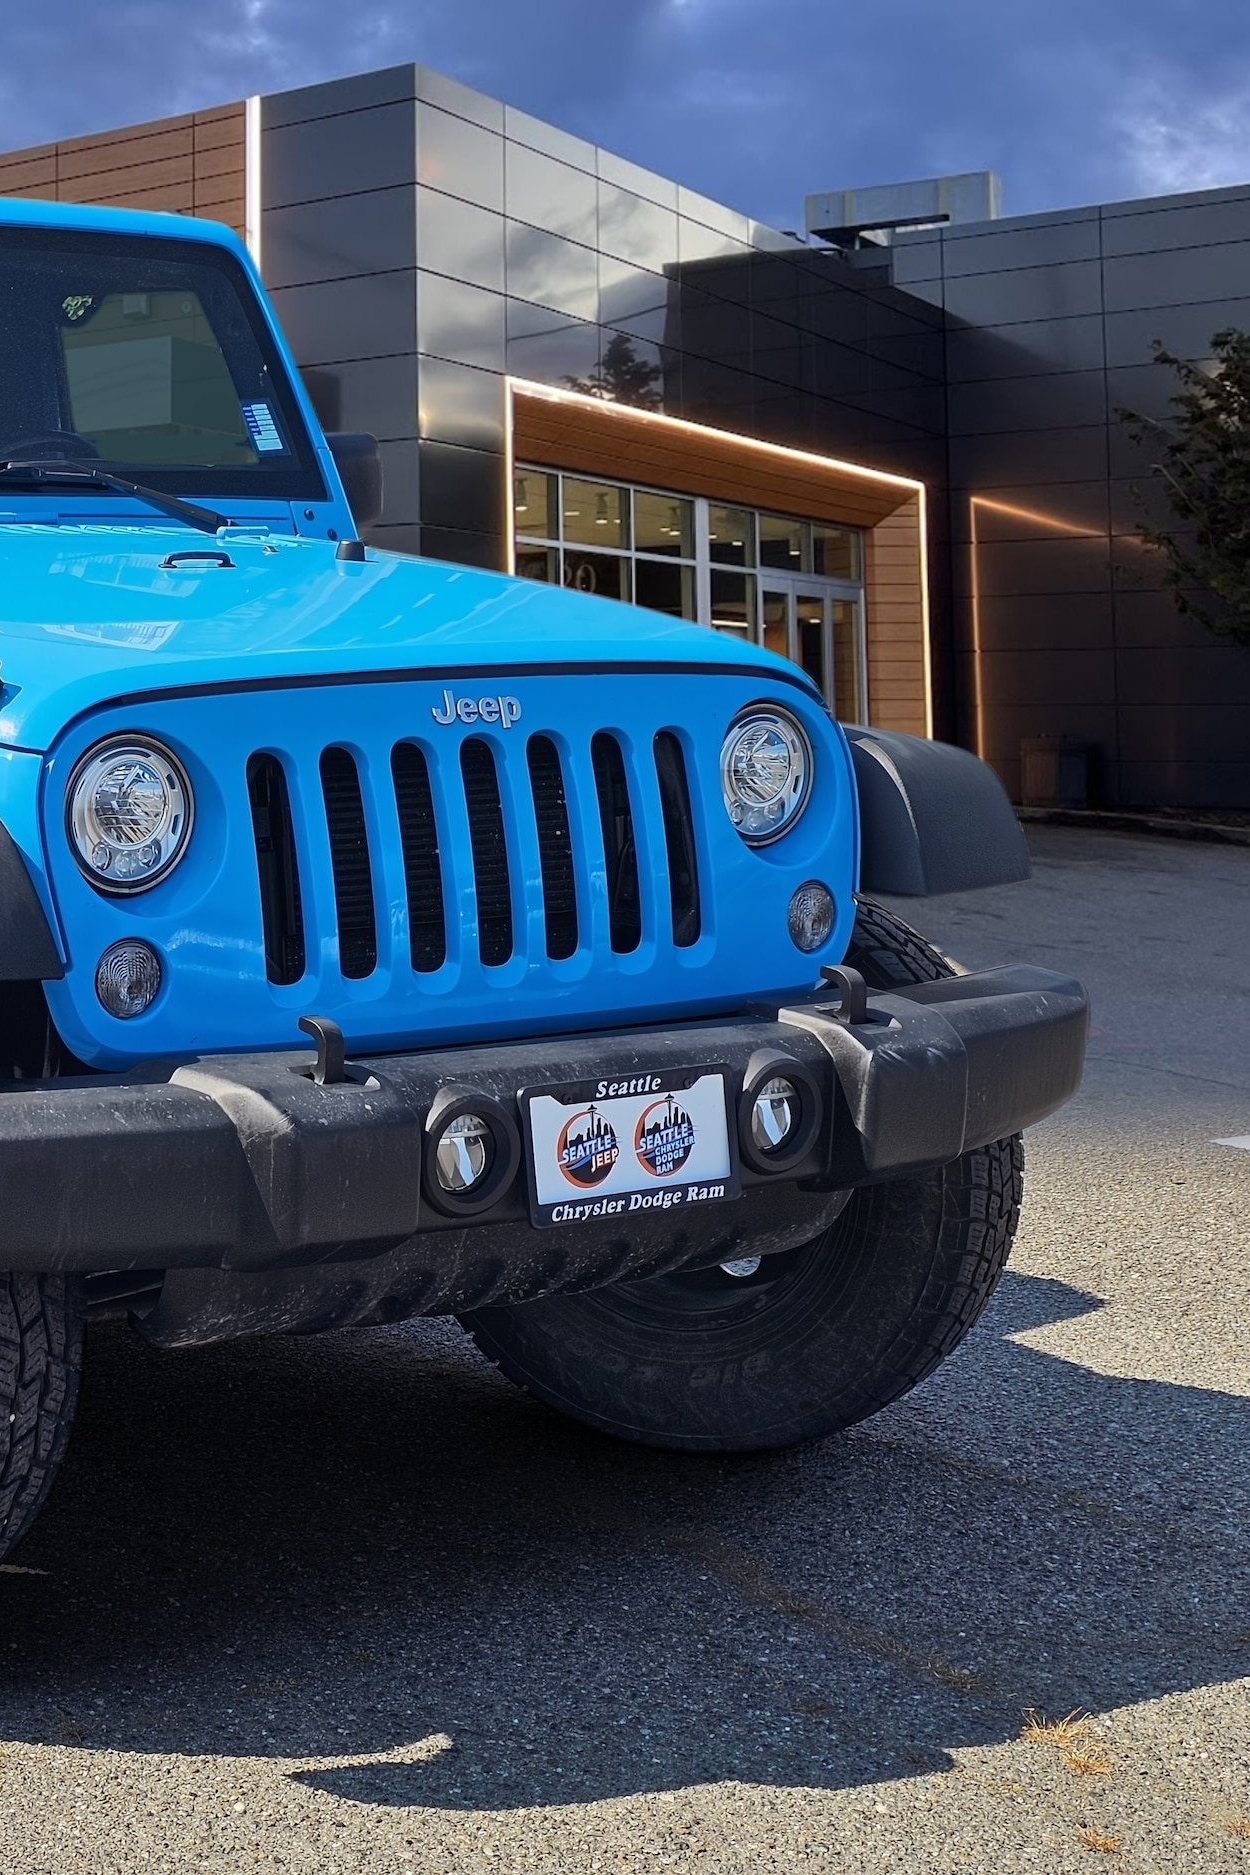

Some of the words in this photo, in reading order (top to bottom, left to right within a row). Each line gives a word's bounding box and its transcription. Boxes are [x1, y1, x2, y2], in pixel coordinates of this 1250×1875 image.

[431, 689, 522, 729] Jeep
[595, 1075, 661, 1098] Seattle
[562, 1134, 611, 1164] SEATTLE
[639, 1123, 688, 1150] SEATTLE
[655, 1134, 695, 1156] CHRYSLER
[591, 1147, 619, 1173] JEEP
[655, 1148, 684, 1165] DODGE
[656, 1163, 673, 1175] RAM
[551, 1198, 625, 1223] Chrysler
[628, 1190, 682, 1212] Dodge
[685, 1184, 725, 1202] Ram
